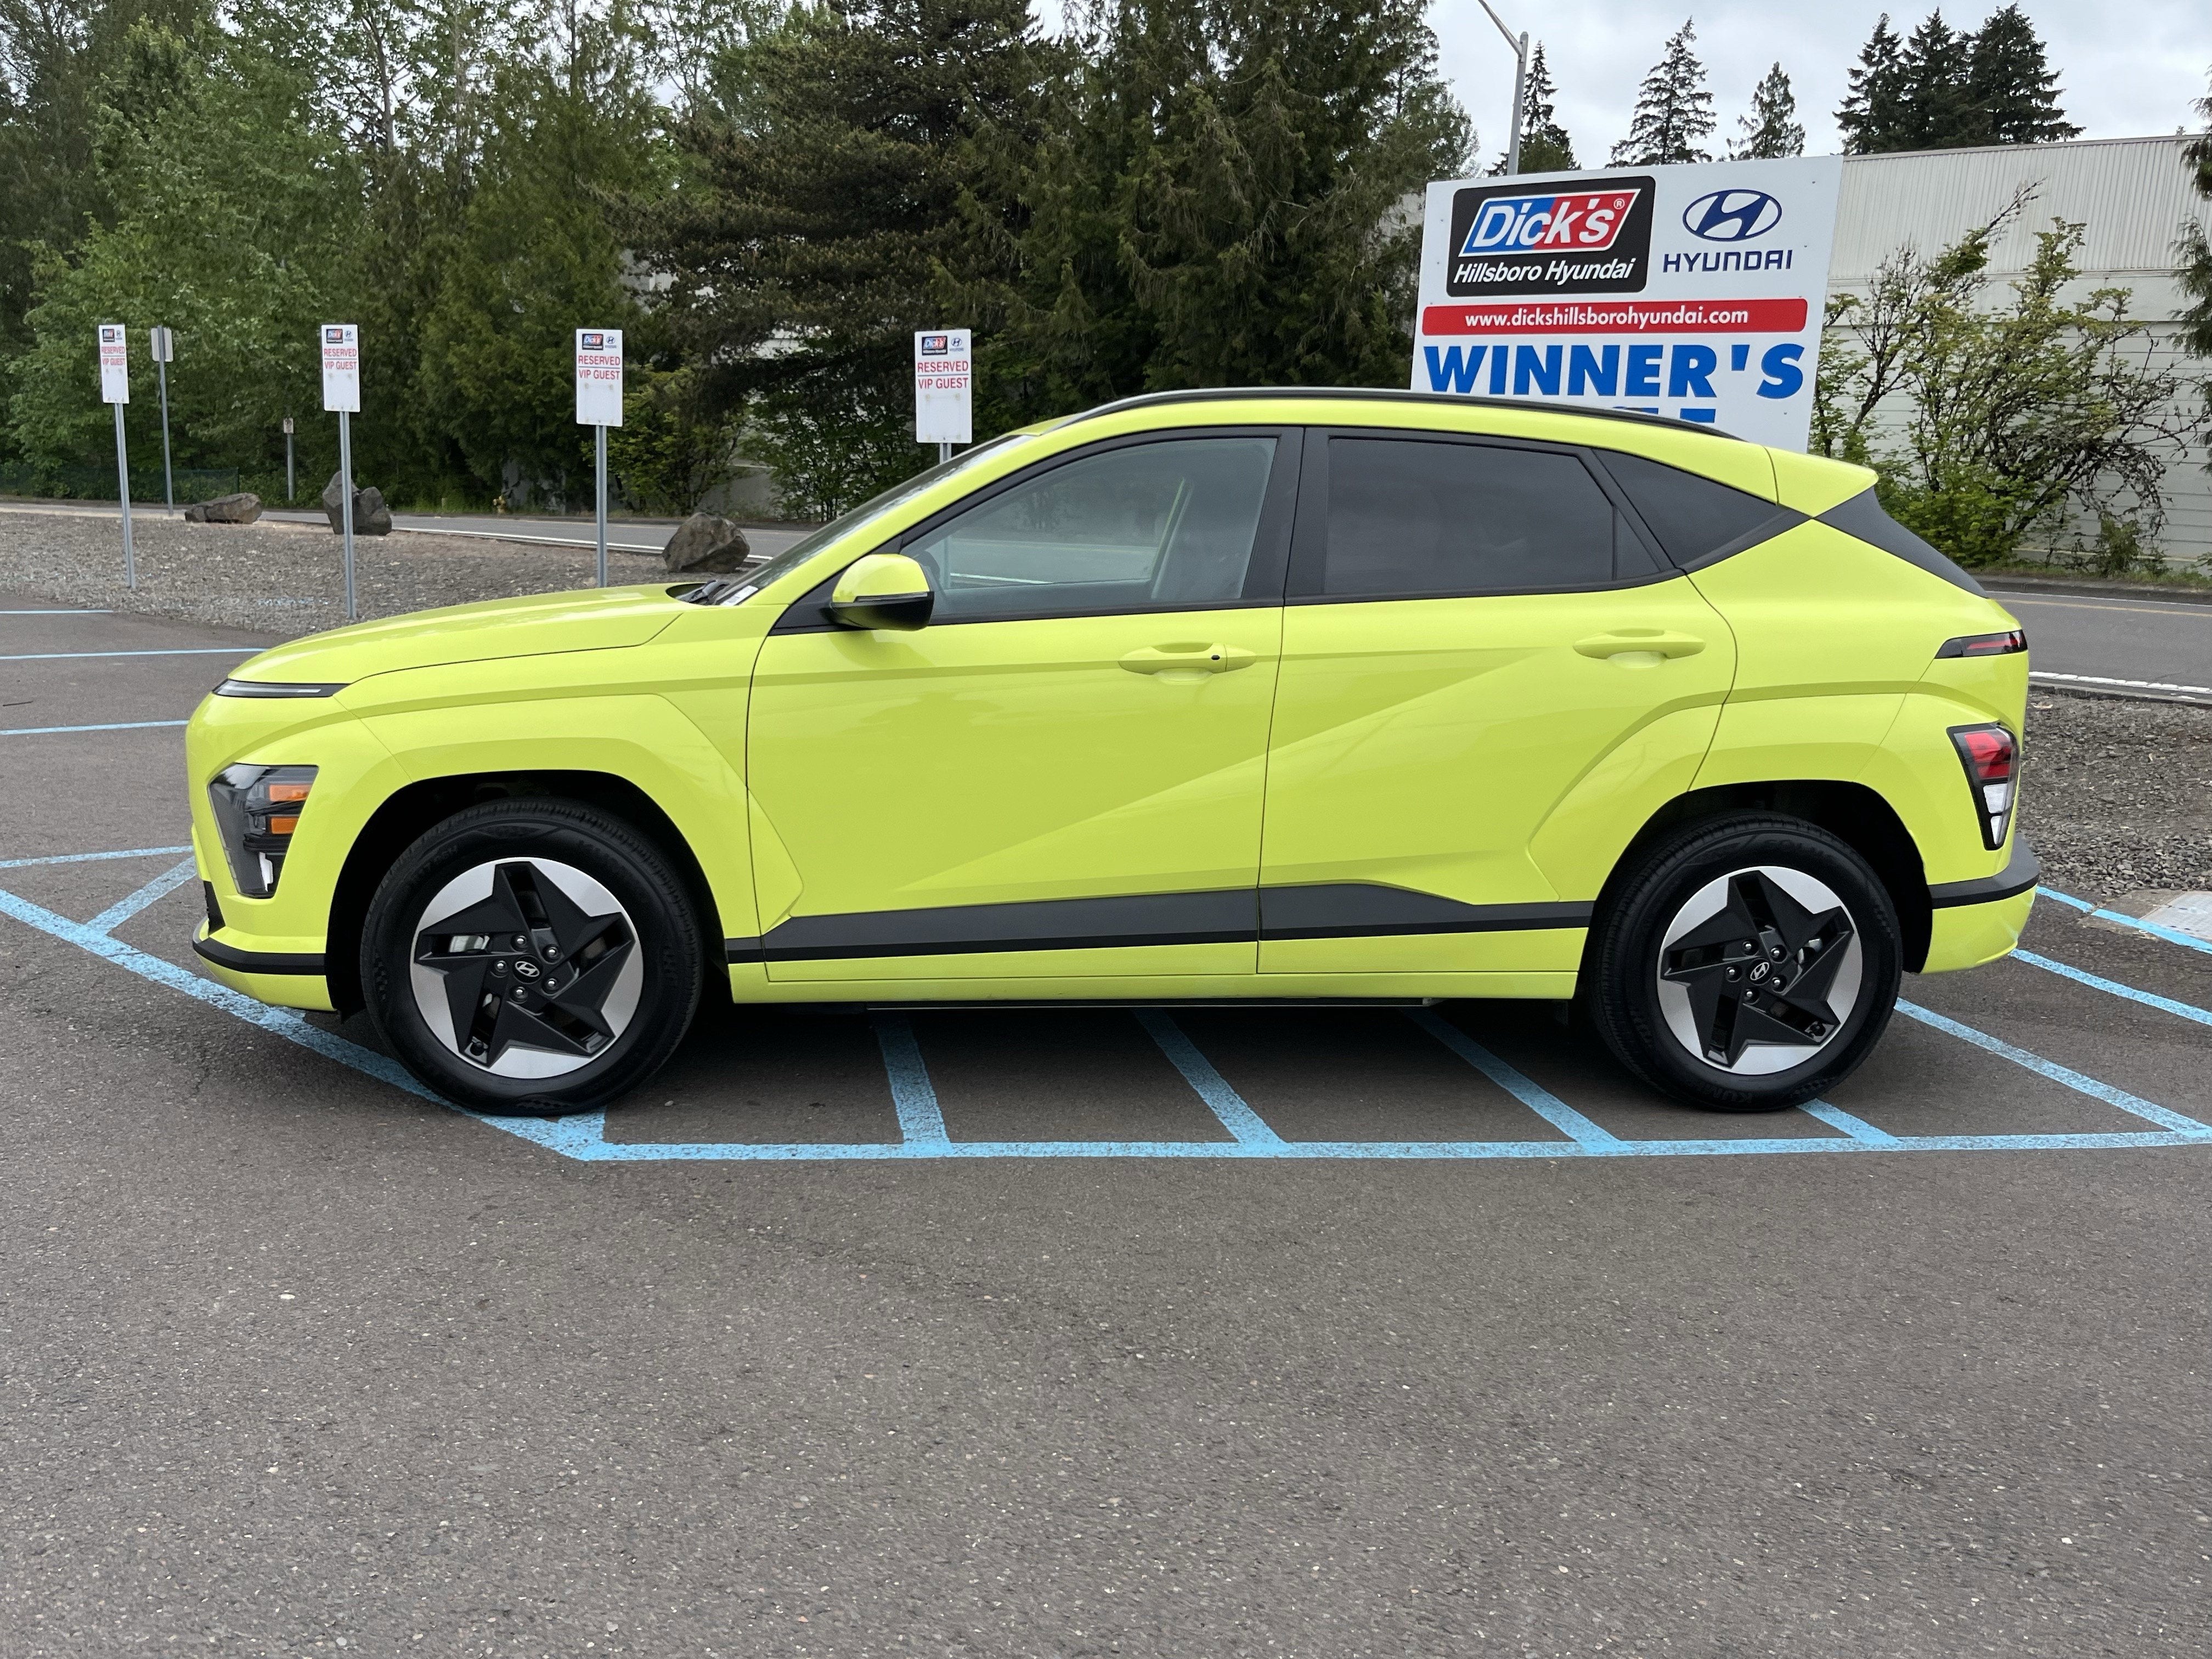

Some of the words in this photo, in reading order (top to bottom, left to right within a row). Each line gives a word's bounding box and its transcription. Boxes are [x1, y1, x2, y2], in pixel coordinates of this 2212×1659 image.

[1663, 250, 1793, 273] HYUNDAI
[1453, 262, 1543, 284] Hillsboro
[1544, 258, 1637, 285] Hyundai
[1465, 305, 1748, 330] www.dickshillsborohyundai.com
[324, 348, 357, 357] RESERVED
[324, 361, 334, 369] VIP
[336, 362, 357, 370] GUEST
[578, 356, 620, 365] RESERVED
[918, 362, 968, 373] RESERVED
[1424, 343, 1805, 399] WINNER'S
[579, 369, 591, 379] VIP
[594, 370, 620, 380] GUEST
[918, 379, 933, 389] VIP
[936, 378, 968, 388] GUEST
